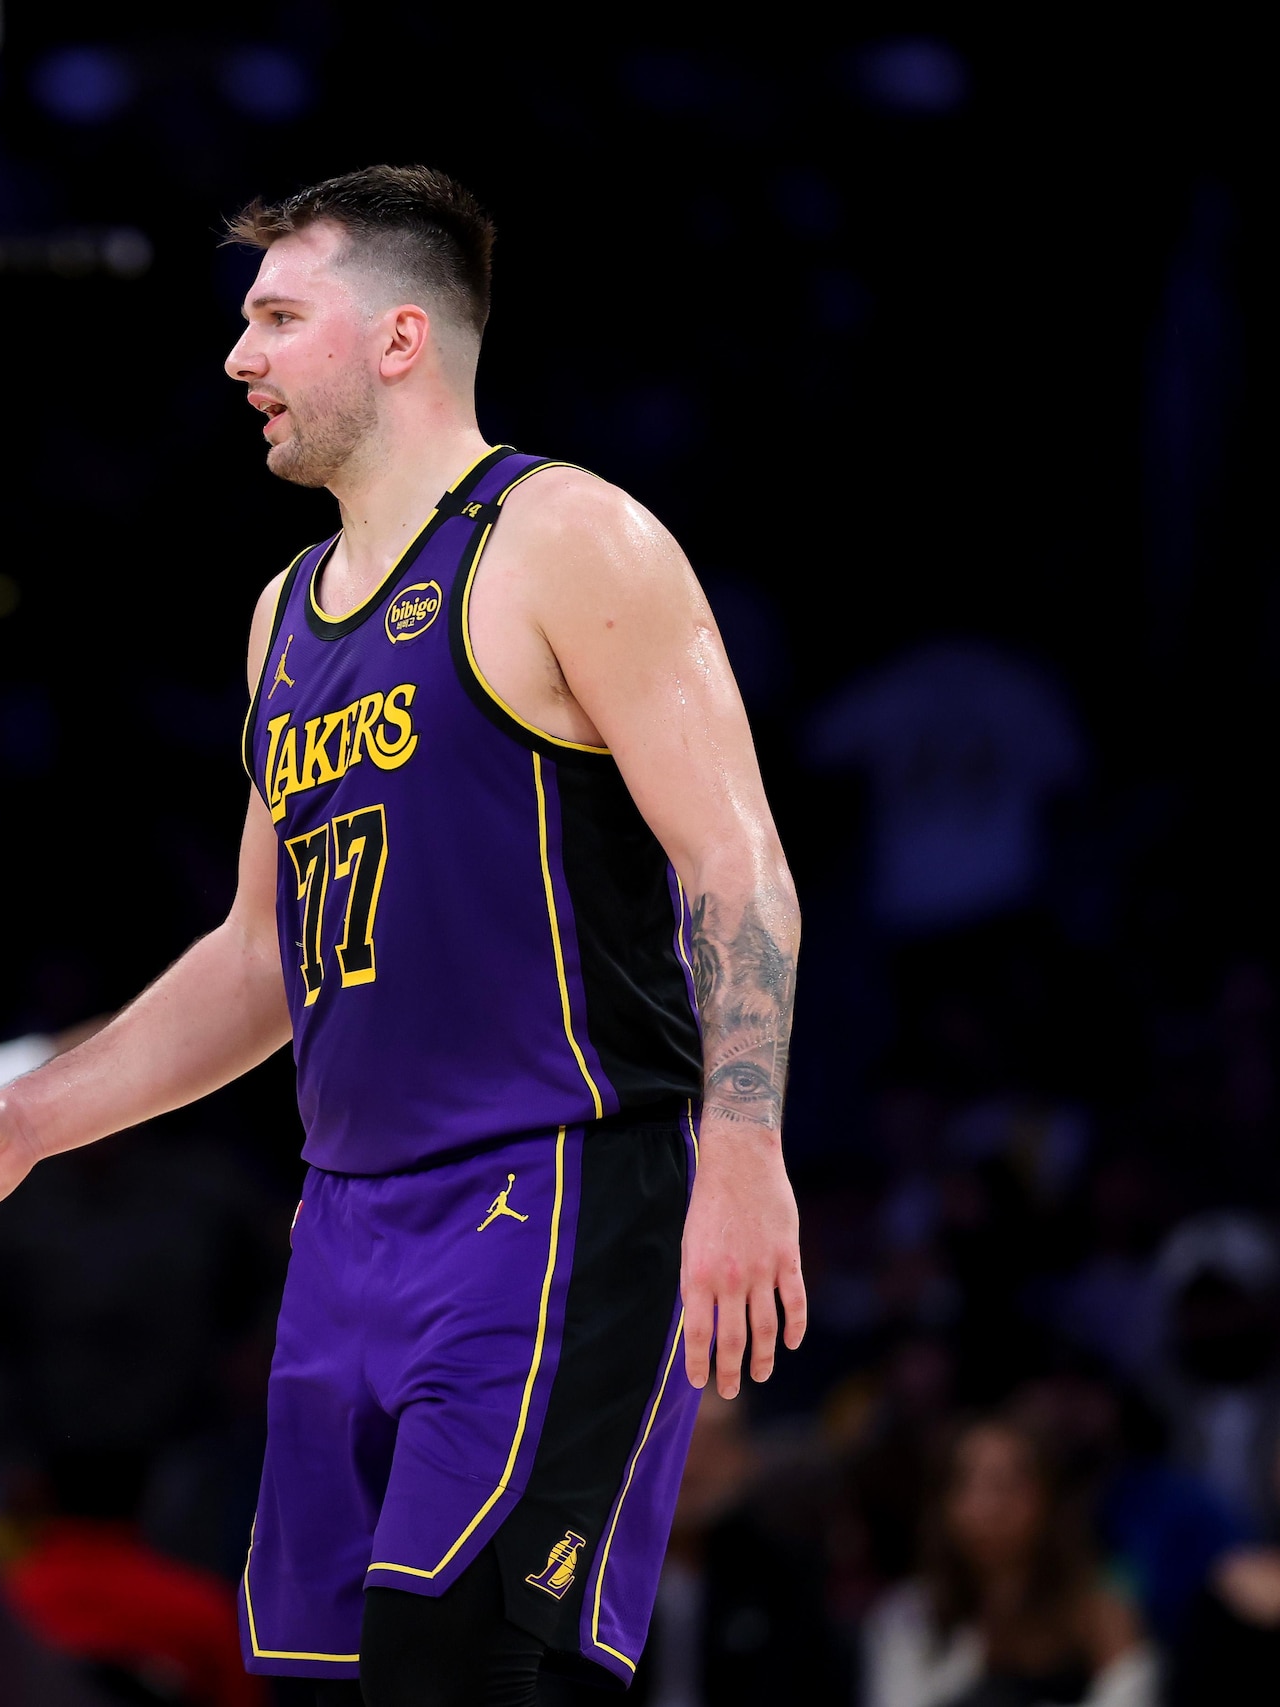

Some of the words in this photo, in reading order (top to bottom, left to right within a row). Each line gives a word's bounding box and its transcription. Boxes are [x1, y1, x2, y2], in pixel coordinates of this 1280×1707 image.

[391, 597, 438, 623] bibigo
[265, 683, 419, 825] LAKERS
[284, 803, 388, 1008] 77
